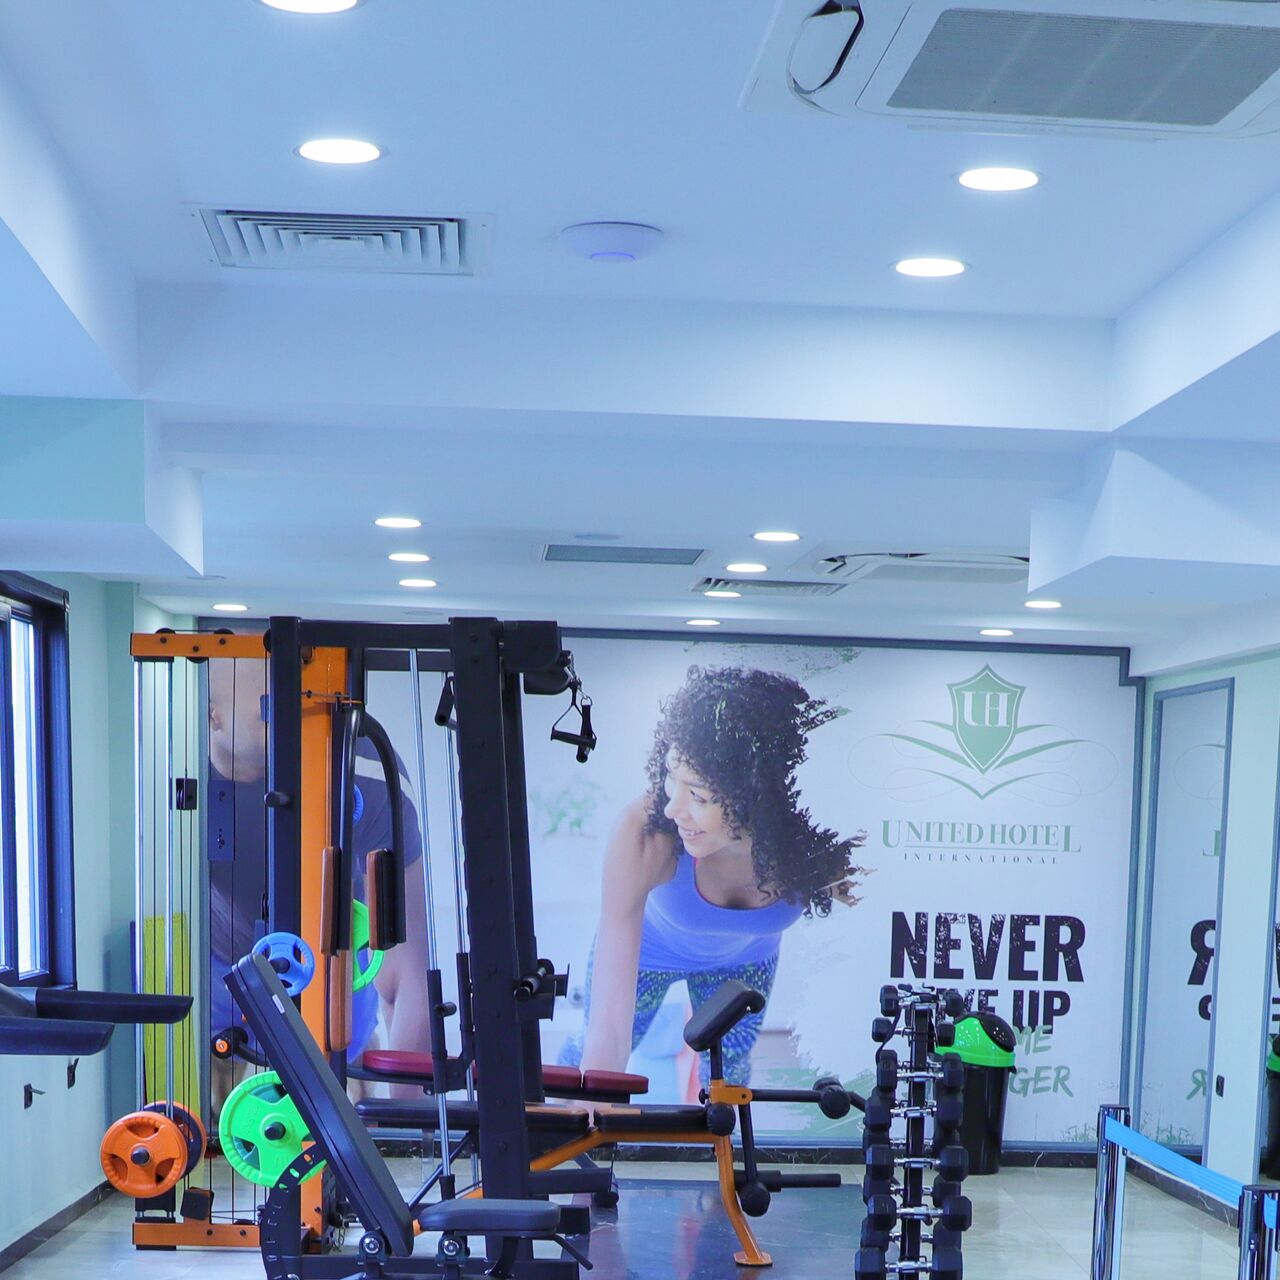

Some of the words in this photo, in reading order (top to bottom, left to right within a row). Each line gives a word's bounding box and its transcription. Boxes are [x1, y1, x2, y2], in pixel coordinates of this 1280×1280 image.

[881, 819, 984, 848] UNITED
[990, 823, 1082, 853] HOTEL
[904, 852, 1058, 865] INTERNATIONAL
[890, 911, 1086, 982] NEVER
[1012, 989, 1071, 1035] UP
